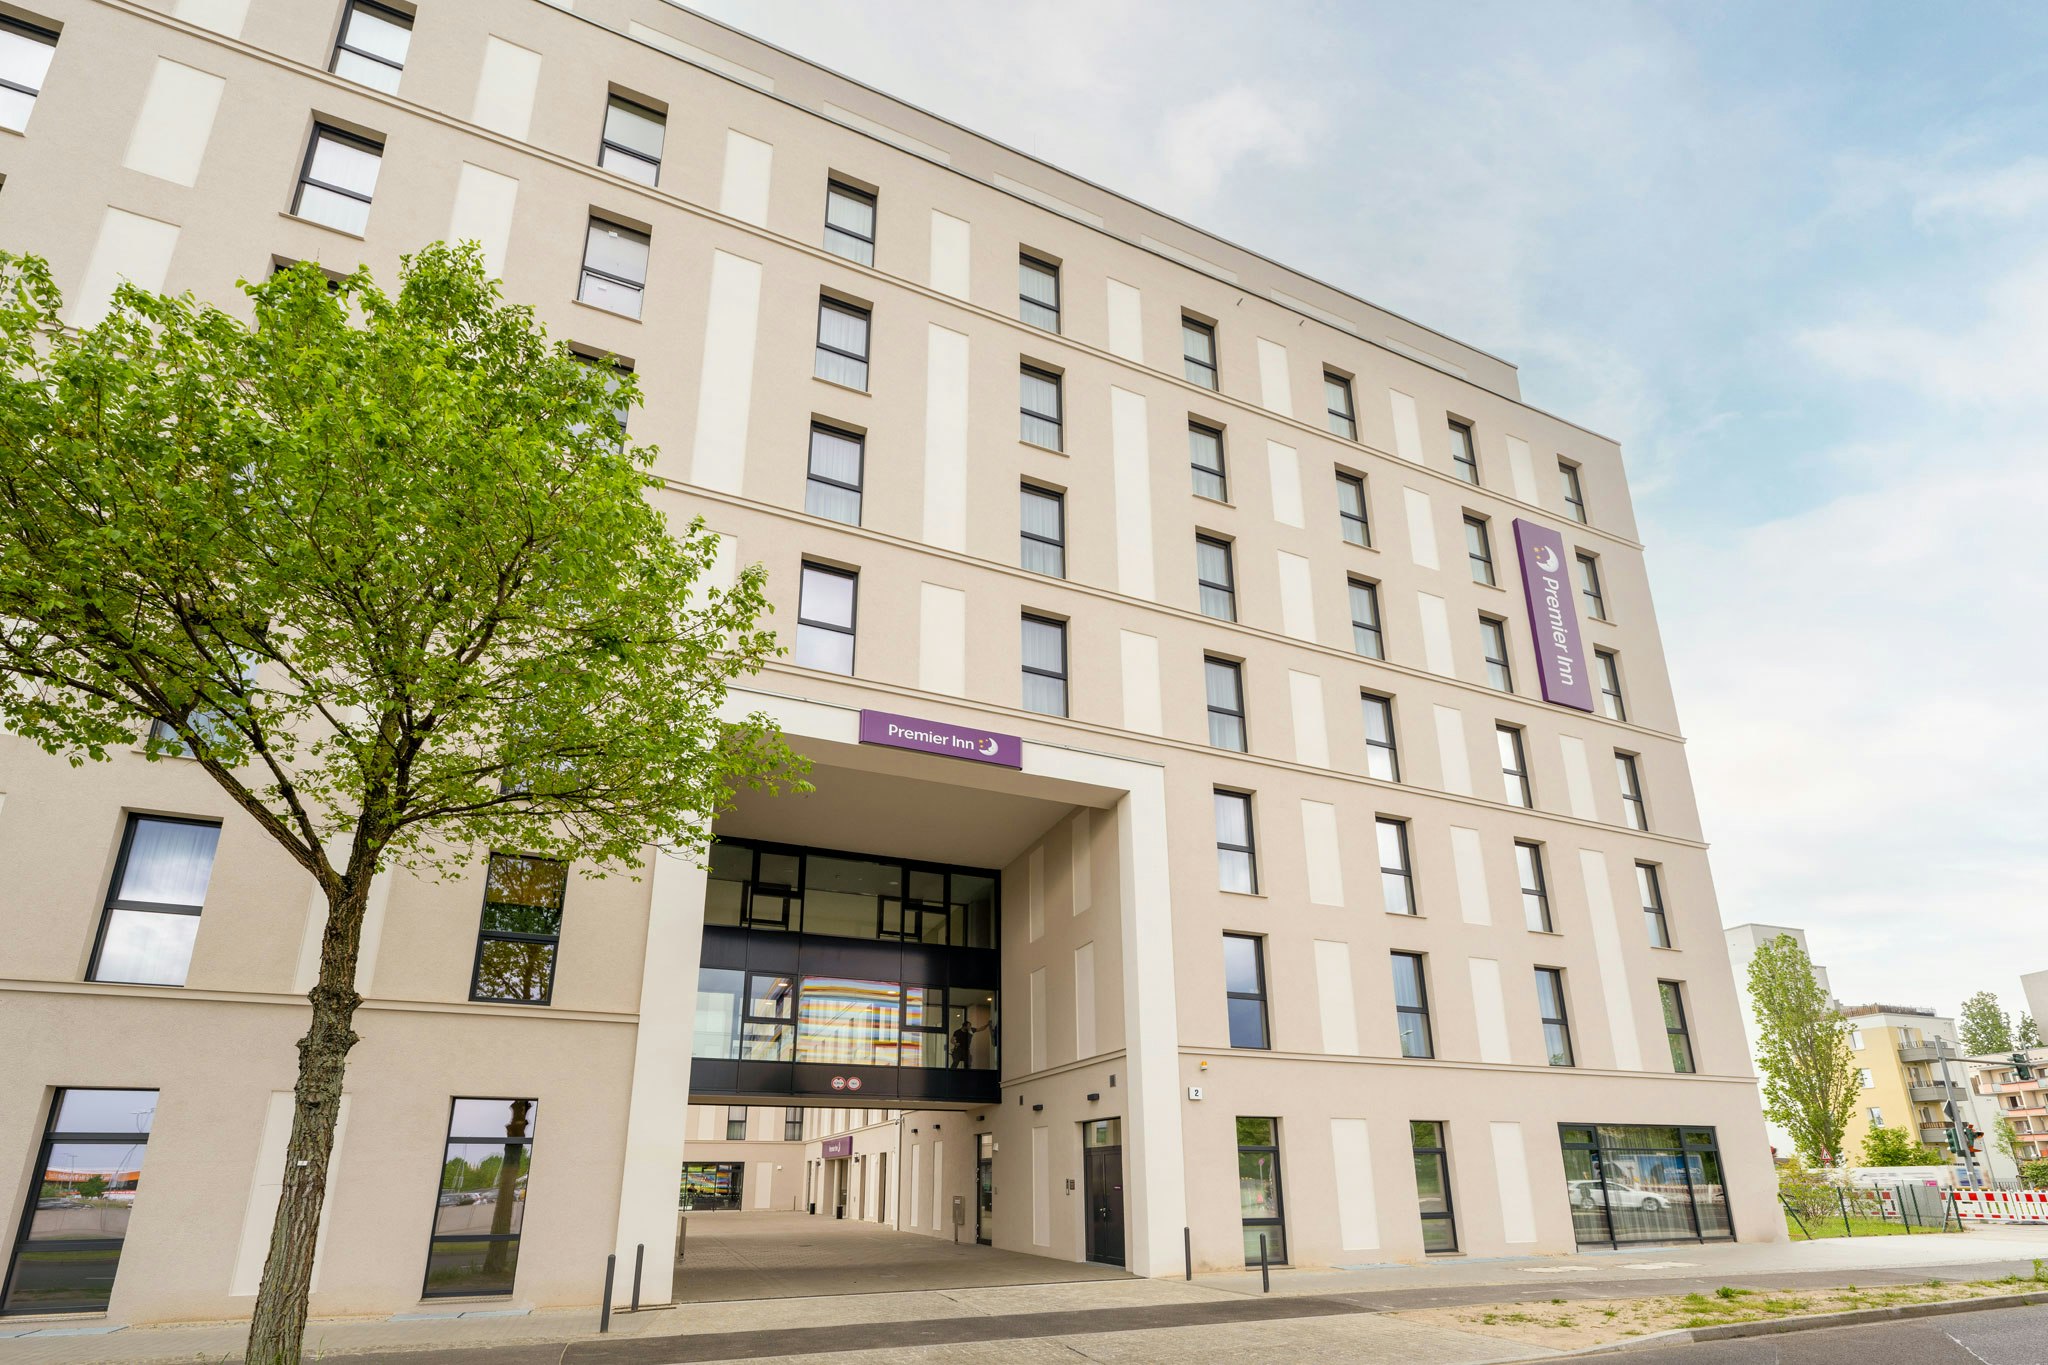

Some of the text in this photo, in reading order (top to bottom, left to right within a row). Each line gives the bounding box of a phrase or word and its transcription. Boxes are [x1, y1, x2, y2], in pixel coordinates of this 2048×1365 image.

[1542, 576, 1574, 686] Premier Inn
[888, 723, 974, 750] Premier Inn
[1194, 1089, 1200, 1097] 2
